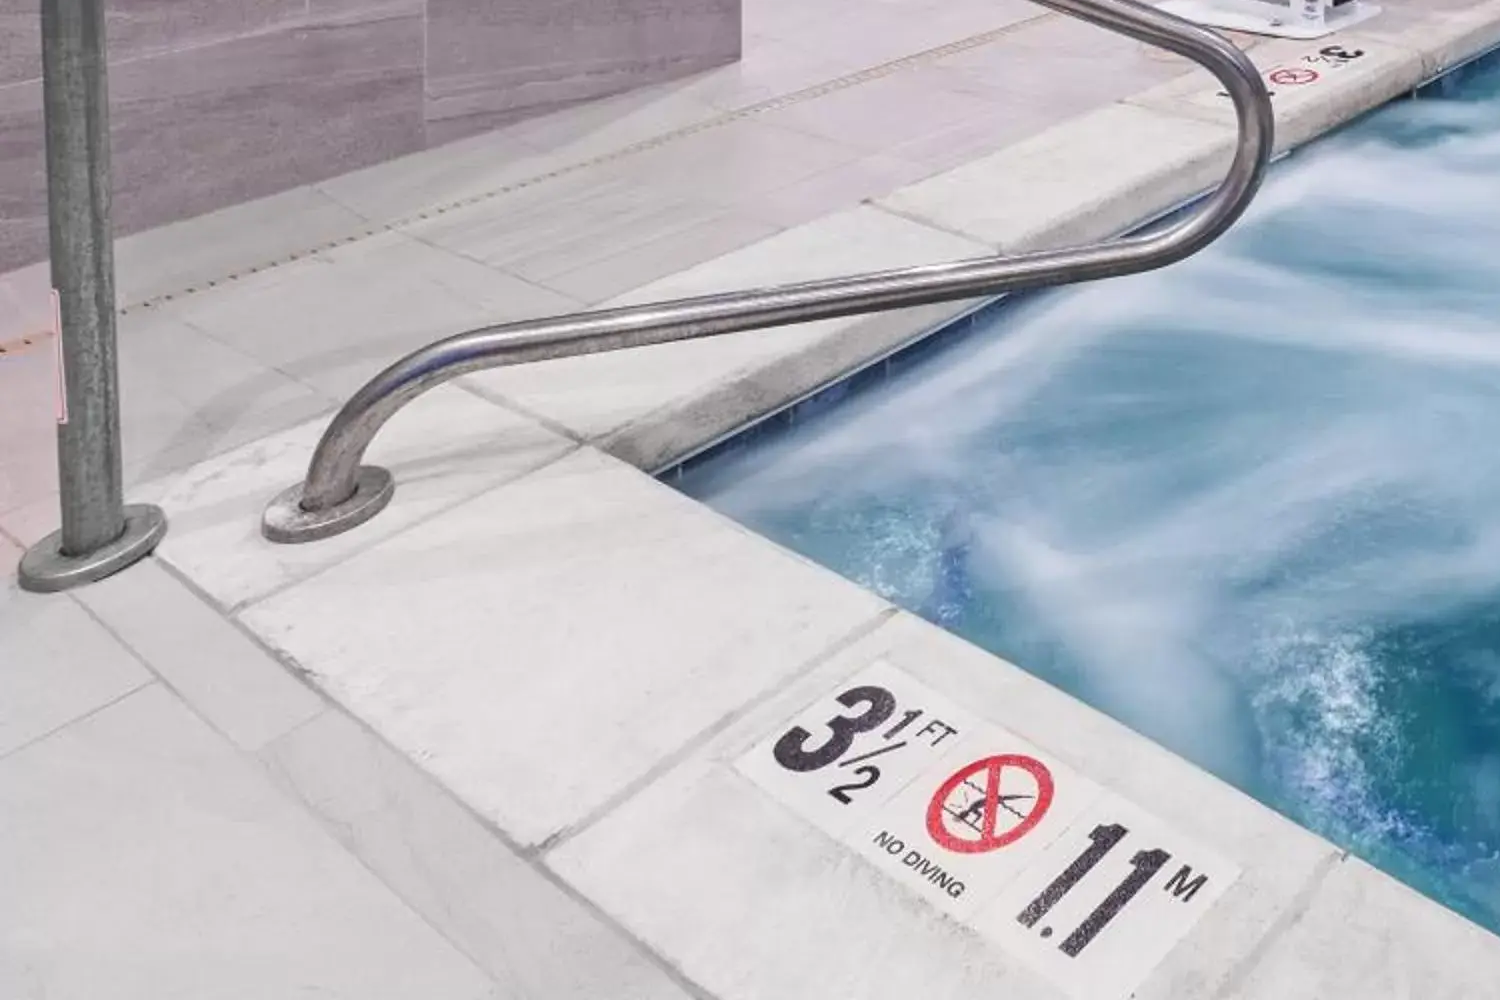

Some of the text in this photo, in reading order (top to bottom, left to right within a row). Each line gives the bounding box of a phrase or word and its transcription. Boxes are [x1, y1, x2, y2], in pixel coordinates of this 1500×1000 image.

[873, 830, 966, 901] NO DIVING
[915, 718, 959, 749] FT
[1016, 822, 1173, 959] 1.1
[1162, 863, 1209, 904] M
